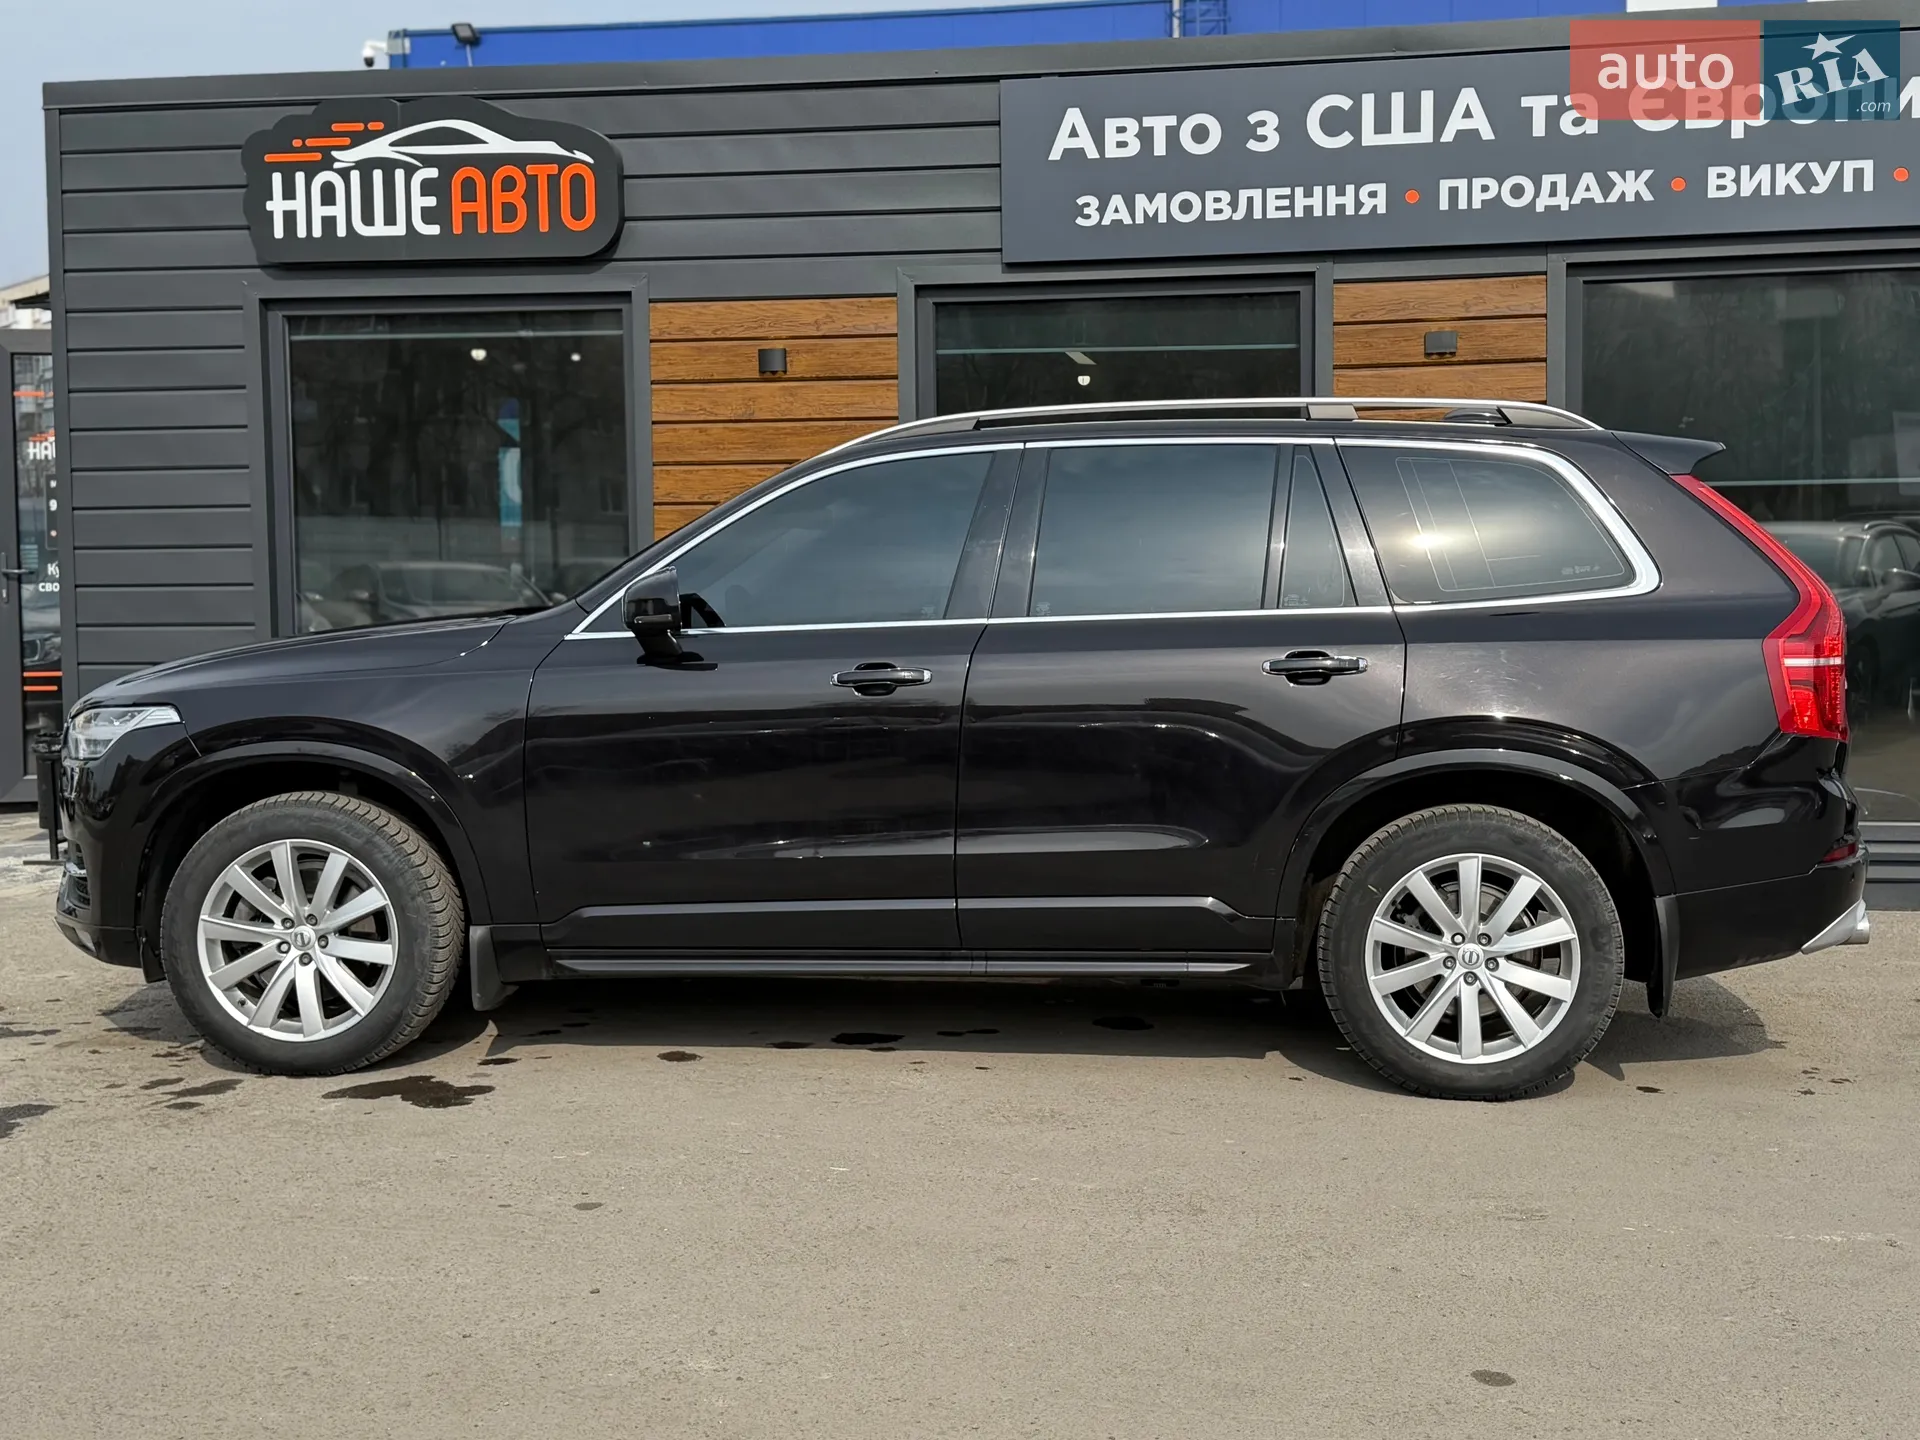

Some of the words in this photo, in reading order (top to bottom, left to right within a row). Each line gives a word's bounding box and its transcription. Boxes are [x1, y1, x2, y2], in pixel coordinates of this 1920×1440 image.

[1048, 107, 1222, 160] Авто
[1306, 87, 1496, 149] США
[1520, 92, 1599, 138] та
[266, 167, 441, 239] НАШЕ
[451, 162, 597, 235] АВТО
[1074, 182, 1387, 227] ЗАМОВЛЕННЯ
[1439, 169, 1655, 213] ПРОДАЖ
[1707, 159, 1874, 199] ВИКУП
[27, 441, 56, 460] НА
